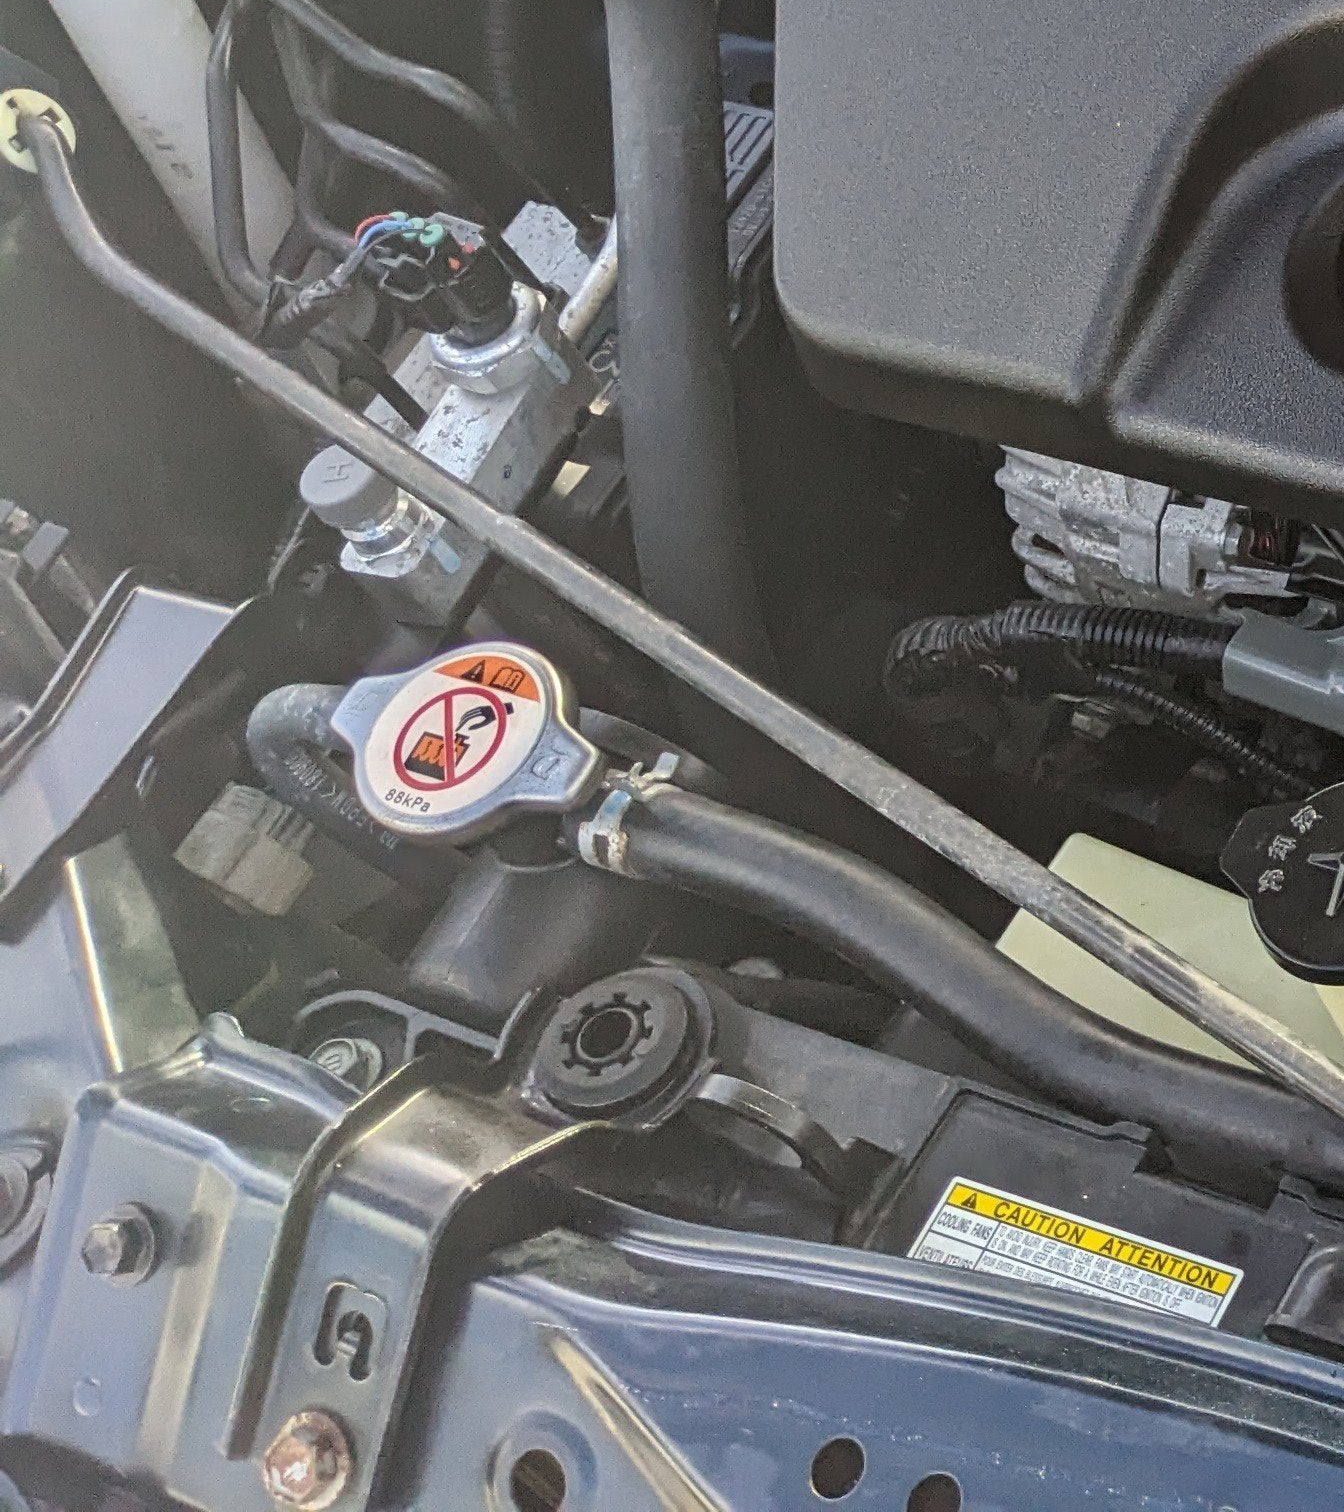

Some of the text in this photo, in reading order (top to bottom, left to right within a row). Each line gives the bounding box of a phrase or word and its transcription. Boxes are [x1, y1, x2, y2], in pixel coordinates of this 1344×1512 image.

[384, 787, 432, 814] 88kPa
[936, 1211, 993, 1239] COOLING FANS
[992, 1201, 1220, 1289] CAUTION ATTENTION
